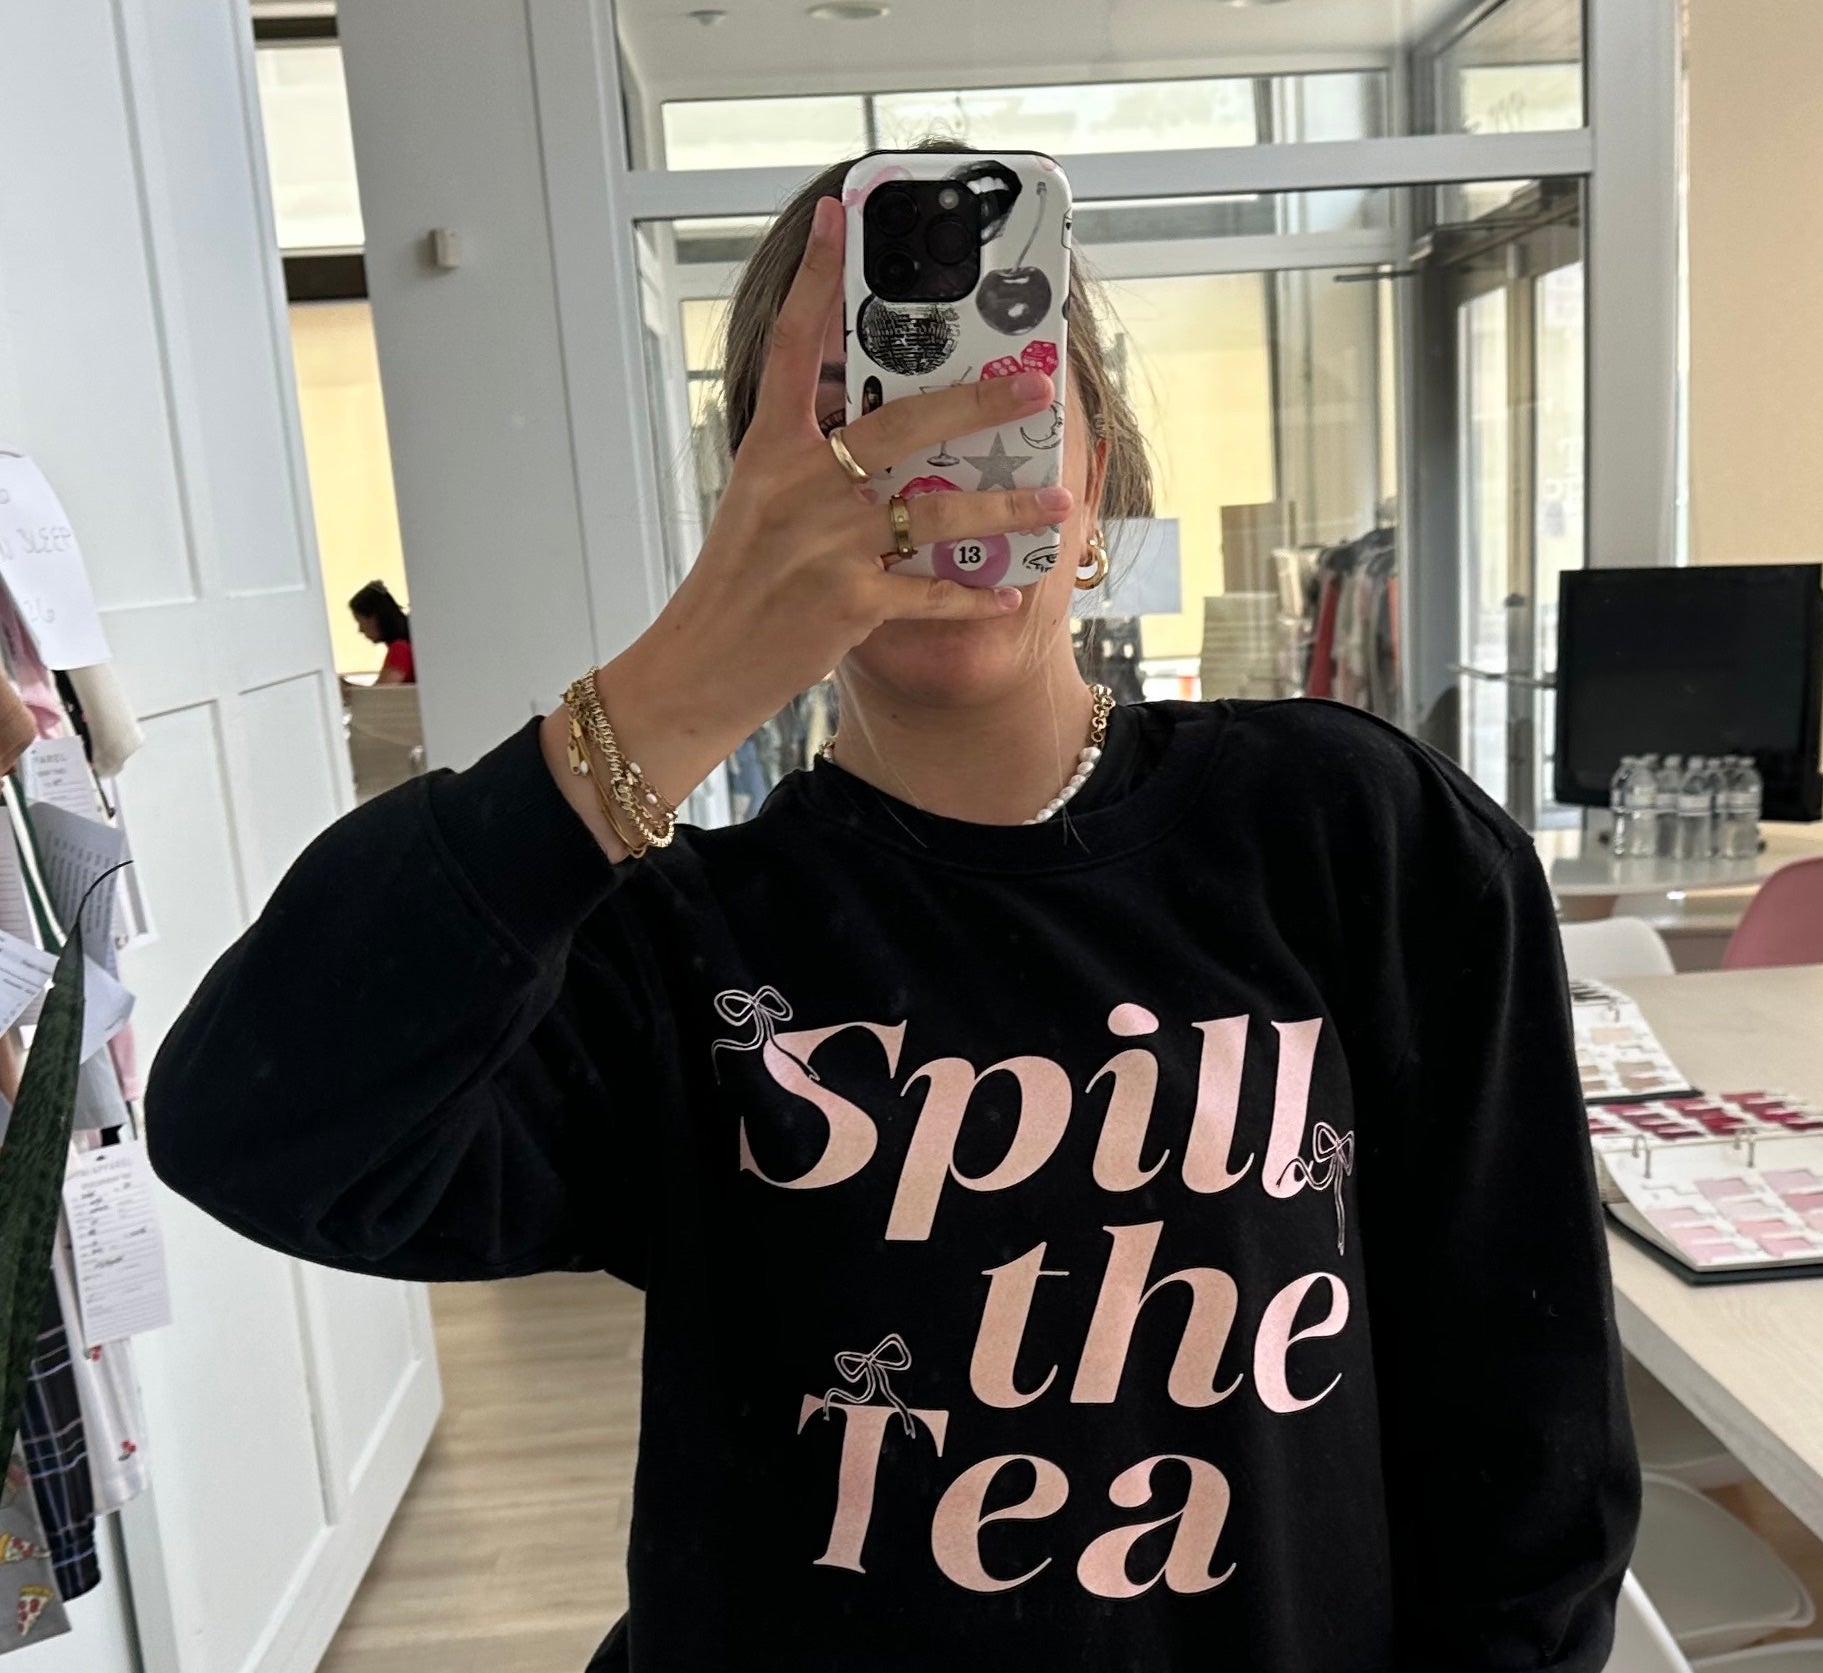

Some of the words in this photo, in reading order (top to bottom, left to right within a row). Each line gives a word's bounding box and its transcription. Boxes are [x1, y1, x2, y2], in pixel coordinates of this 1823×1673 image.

[959, 545, 981, 564] 13
[739, 1002, 1324, 1241] Spill
[969, 1219, 1350, 1414] the
[797, 1393, 1237, 1598] Tea
